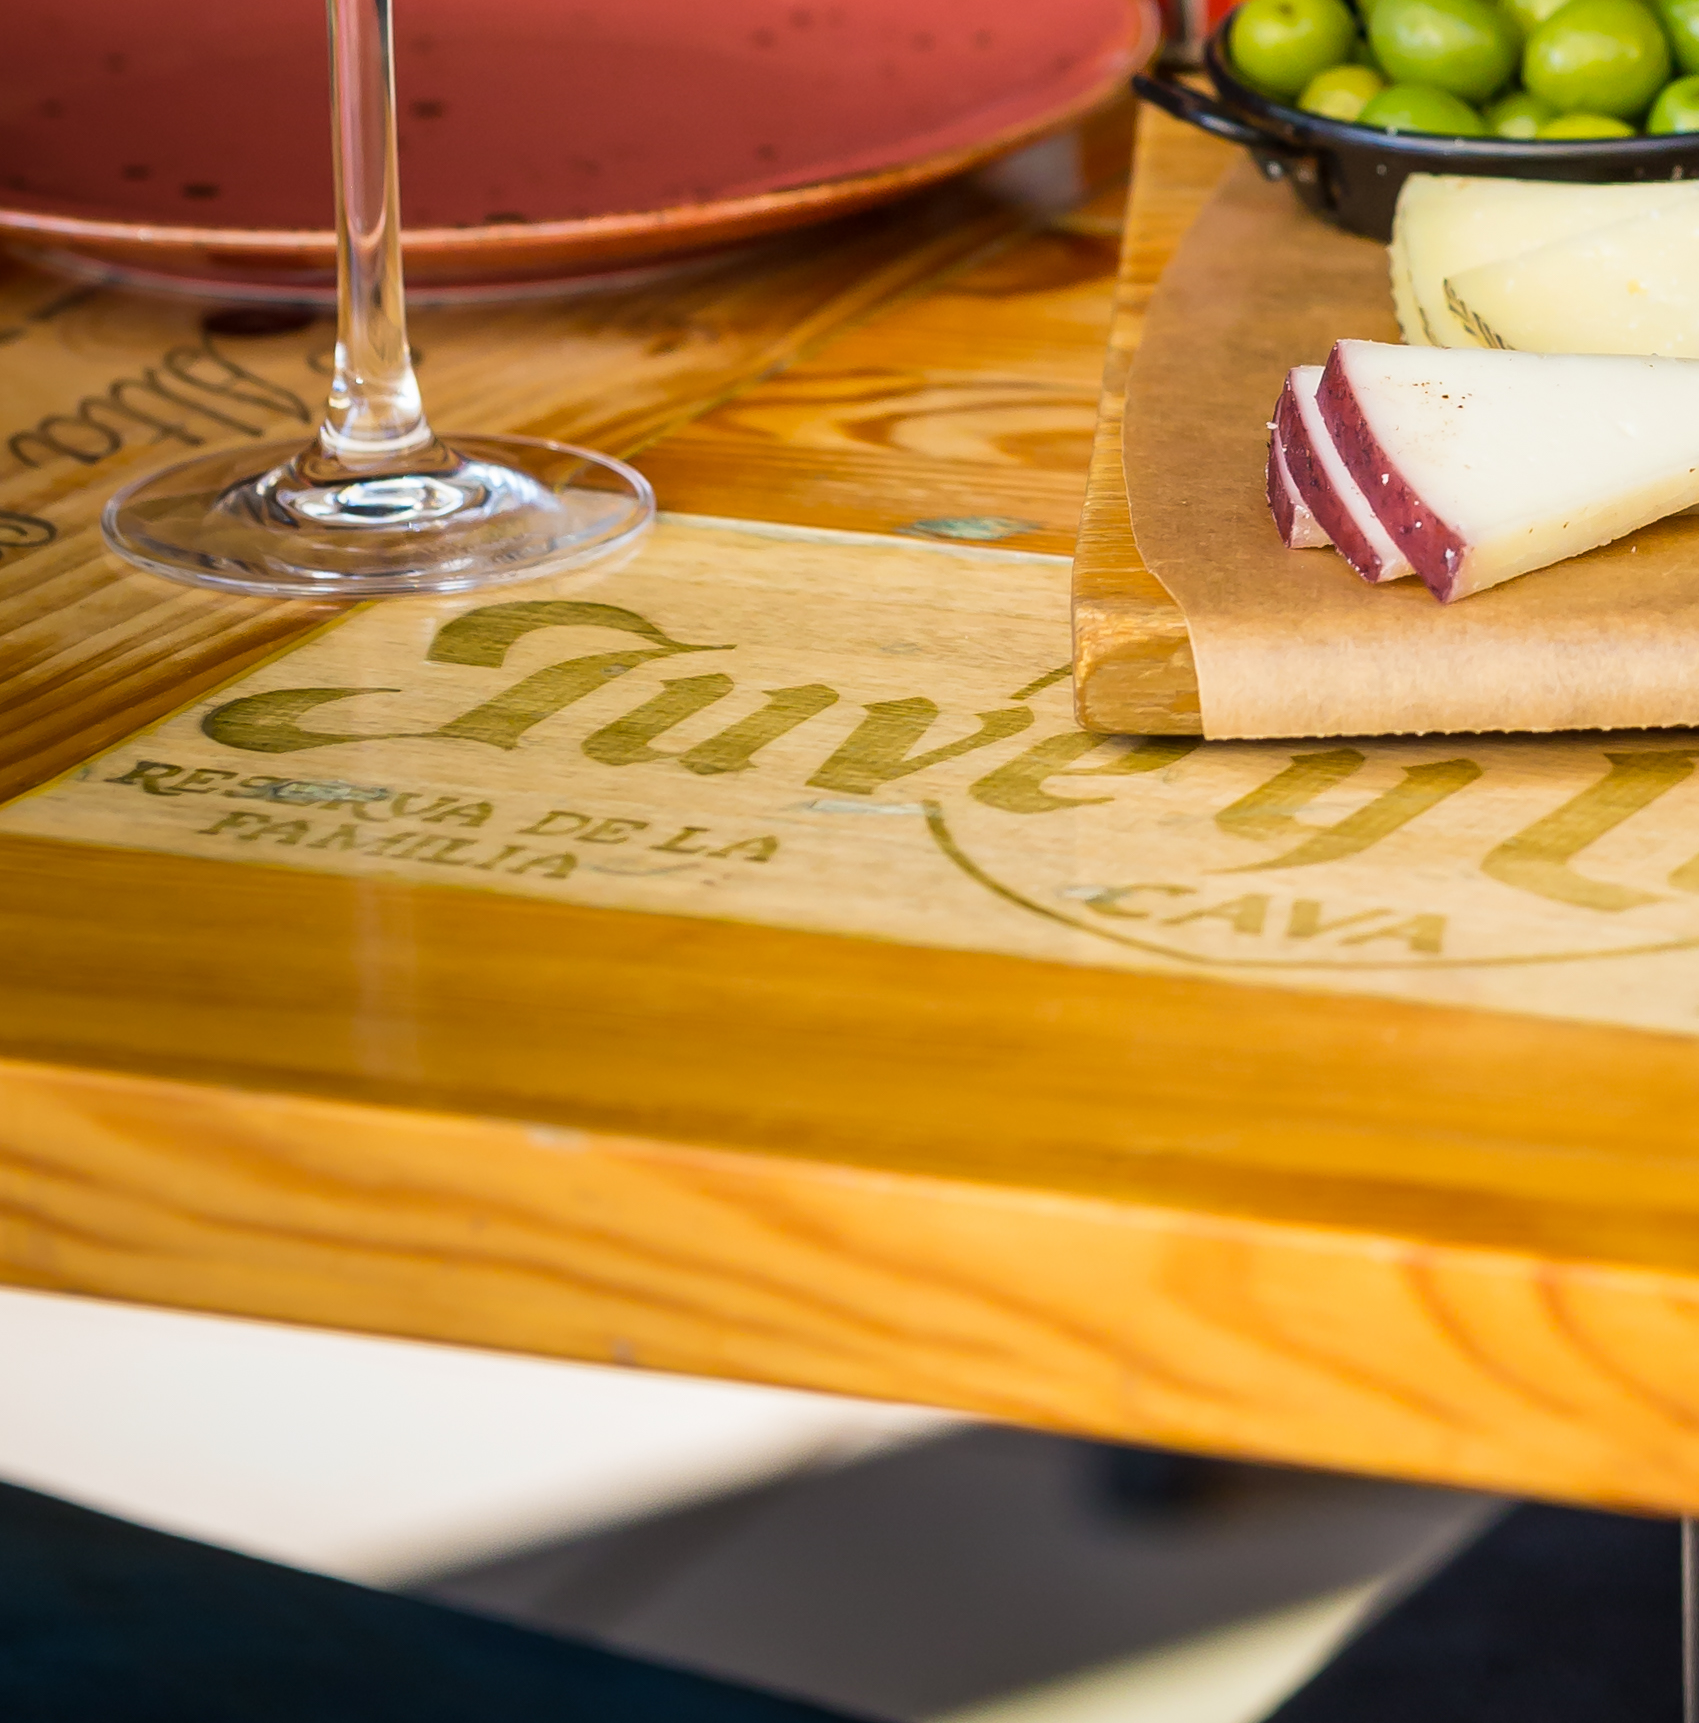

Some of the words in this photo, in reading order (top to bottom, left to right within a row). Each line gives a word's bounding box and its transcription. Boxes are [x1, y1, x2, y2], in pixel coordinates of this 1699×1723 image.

[104, 760, 495, 830] RESERVA
[518, 809, 651, 846] DE
[650, 825, 780, 865] LA
[197, 810, 580, 881] FAMILIA
[1080, 882, 1449, 955] CAVA
